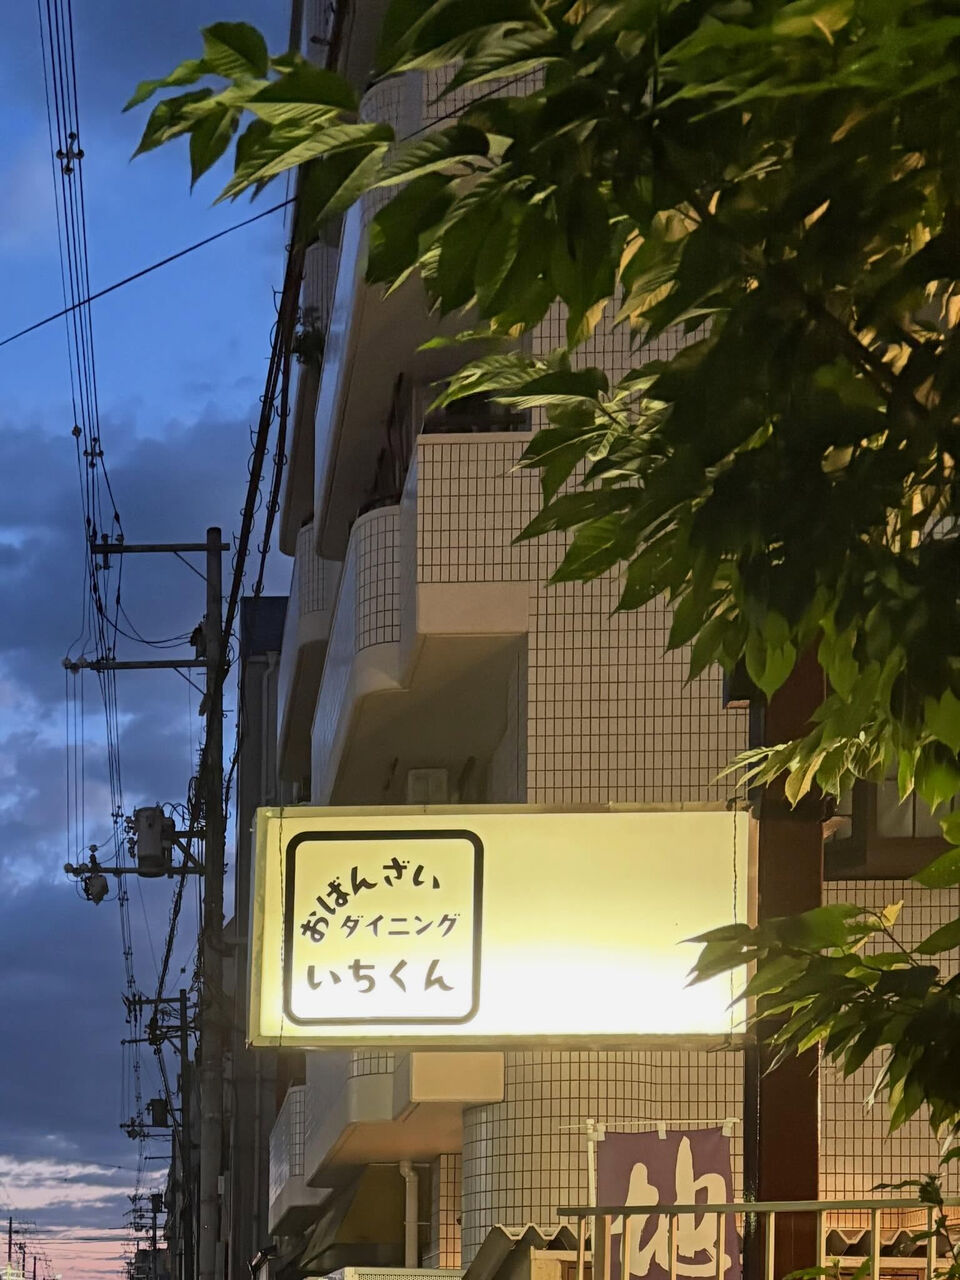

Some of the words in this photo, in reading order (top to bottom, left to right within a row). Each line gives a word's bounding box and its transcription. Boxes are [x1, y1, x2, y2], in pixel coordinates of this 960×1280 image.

[300, 857, 440, 943] おばんざい
[340, 914, 461, 938] ダイニング
[307, 959, 454, 993] いちくん
